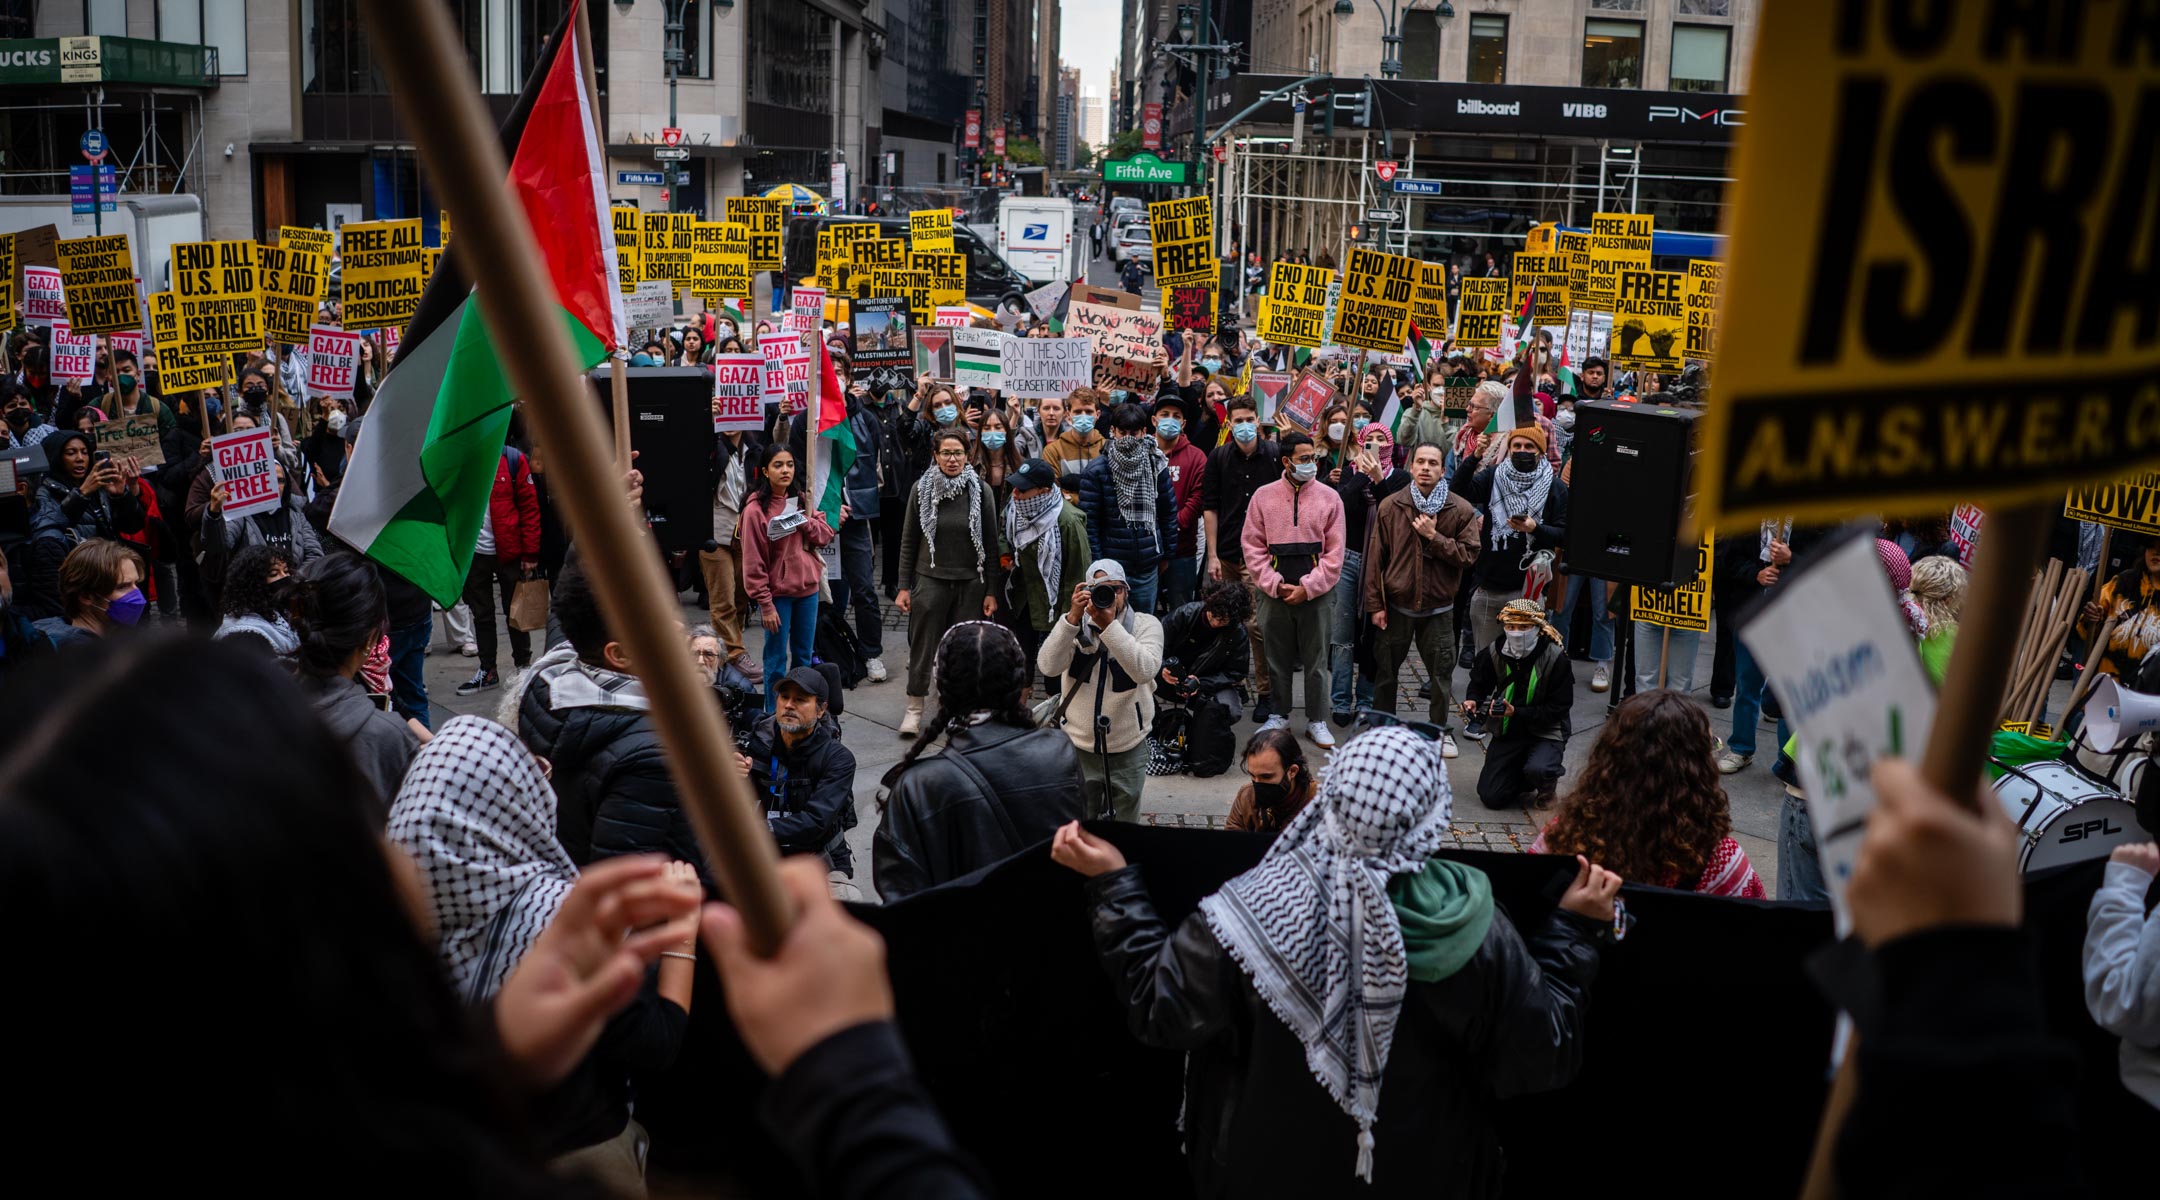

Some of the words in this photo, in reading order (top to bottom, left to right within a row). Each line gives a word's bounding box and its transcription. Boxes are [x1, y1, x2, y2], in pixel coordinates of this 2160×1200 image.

[0, 50, 51, 67] UCKS
[63, 50, 98, 61] KINGS
[1457, 99, 1520, 116] billboard
[625, 131, 711, 146] ANAZ
[625, 174, 643, 183] Fifth
[644, 175, 658, 183] Ave
[1115, 165, 1144, 179] Fifth
[1148, 167, 1173, 179] Ave
[1401, 183, 1418, 192] Fifth
[1419, 184, 1434, 193] Ave
[728, 199, 781, 213] PALESTINE
[1151, 198, 1209, 222] PALESTINE
[644, 215, 668, 232] END
[672, 213, 693, 231] ALL
[764, 214, 780, 232] BE
[912, 215, 934, 230] FREE
[936, 214, 951, 228] ALL
[1154, 219, 1190, 243] WILL
[1193, 215, 1210, 239] BE
[1593, 218, 1625, 236] FREE
[1627, 219, 1651, 237] ALL
[281, 228, 333, 243] RESISTANCE
[343, 230, 388, 252] FREE
[391, 226, 420, 248] ALL
[645, 232, 668, 249] U.S.
[672, 233, 692, 249] AID
[694, 227, 722, 242] FREE
[725, 226, 748, 242] ALL
[912, 229, 953, 241] PALESTINIAN
[57, 237, 127, 257] RESISTANCE
[288, 240, 325, 253] AGAINST
[693, 243, 747, 254] PALESTINIAN
[852, 240, 902, 263] FREE
[1591, 236, 1651, 251] PALESTINIAN
[71, 253, 118, 271] AGAINST
[176, 244, 214, 270] END
[221, 242, 253, 268] ALL
[290, 254, 319, 276] ALL
[343, 249, 421, 269] PALESTINIAN
[655, 251, 692, 262] APARTHEID
[1156, 240, 1211, 276] FREE!
[1516, 256, 1545, 273] FREE
[1547, 256, 1570, 273] ALL
[646, 263, 691, 279] ISRAEL!
[693, 263, 746, 277] POLITICAL
[912, 254, 962, 278] FREE
[1350, 251, 1385, 276] END
[1386, 256, 1415, 283] ALL
[28, 276, 60, 291] GAZA
[62, 267, 132, 286] OCCUPATION
[179, 271, 218, 297] U.S.
[223, 268, 253, 294] AID
[693, 278, 746, 290] PRISONERS
[873, 271, 932, 288] PALESTINE
[1190, 271, 1213, 281] Coalition
[1275, 264, 1302, 284] END
[1305, 269, 1329, 288] ALL
[1421, 268, 1443, 286] ALL
[1514, 275, 1569, 287] PALESTINIAN
[28, 290, 48, 300] WILL
[68, 290, 79, 303] IS
[92, 284, 134, 301] HUMAN
[288, 275, 316, 297] AID
[345, 277, 420, 301] POLITICAL
[1274, 282, 1298, 303] U.S.
[1302, 286, 1326, 306] AID
[1346, 273, 1378, 299] U.S.
[1381, 277, 1412, 304] AID
[1463, 280, 1507, 294] PALESTINE
[1621, 271, 1682, 302] FREE
[264, 296, 314, 314] APARTHEID
[795, 295, 821, 308] GAZA
[911, 289, 930, 308] BE
[1175, 289, 1207, 305] SHUT
[1463, 295, 1489, 312] WILL
[1490, 294, 1505, 311] BE
[28, 300, 61, 315] FREE
[70, 298, 139, 328] RIGHT!
[181, 302, 195, 317] TO
[200, 298, 256, 316] APARTHEID
[344, 297, 420, 320] PRISONERS
[795, 307, 809, 316] WILL
[811, 307, 821, 316] BE
[1182, 303, 1201, 316] IT
[1282, 304, 1324, 321] APARTHEID
[1343, 298, 1354, 312] TO
[1356, 302, 1407, 321] APARTHEID
[1615, 299, 1683, 317] PALESTINE
[185, 314, 257, 342] ISRAEL!
[1125, 315, 1160, 335] many
[1174, 314, 1211, 330] DOWN
[1270, 315, 1320, 339] ISRAEL!
[1339, 312, 1403, 343] ISRAEL!
[1458, 315, 1501, 338] FREE!
[985, 338, 999, 347] AID
[1074, 325, 1108, 337] more
[1115, 331, 1145, 344] need
[1146, 331, 1160, 348] to
[1098, 337, 1124, 353] for
[1297, 337, 1321, 347] Coalition
[1334, 334, 1372, 348] A.N.S.W.E.R.
[1372, 341, 1401, 352] Coalition
[55, 344, 76, 356] WILL
[79, 346, 91, 356] BE
[183, 343, 228, 354] A.N.S.W.E.R.
[228, 340, 261, 351] Coalition
[313, 336, 353, 356] GAZA
[854, 350, 897, 359] PALESTINIANS
[1003, 341, 1024, 361] ON
[1027, 342, 1051, 360] THE
[1055, 341, 1088, 360] SIDE
[54, 355, 91, 373] FREE
[313, 353, 336, 367] WILL
[339, 356, 352, 368] BE
[851, 360, 881, 368] FREEDOM
[1003, 359, 1024, 377] OF
[1029, 359, 1088, 377] HUMANITY
[1094, 350, 1107, 363] it
[1113, 356, 1125, 368] a
[311, 364, 352, 385] FREE
[719, 367, 760, 384] GAZA
[719, 385, 743, 397] WILL
[746, 385, 760, 396] BE
[1445, 387, 1473, 398] FREE
[719, 396, 760, 415] FREE
[96, 425, 123, 442] Free
[126, 420, 159, 438] Gaza
[1735, 400, 2112, 488] A.N.S.W.E.R.
[219, 442, 267, 467] GAZA
[222, 463, 251, 481] WILL
[254, 459, 269, 474] BE
[225, 472, 273, 502] FREE
[2070, 480, 2160, 525] NOW!
[2076, 511, 2089, 519] Party
[1953, 515, 1968, 539] WILL
[1637, 586, 1703, 618] ISRAEL!
[1634, 612, 1672, 624] A.N.S.W.E.R.
[1673, 617, 1706, 629] Coalition
[2059, 818, 2122, 844] SPL
